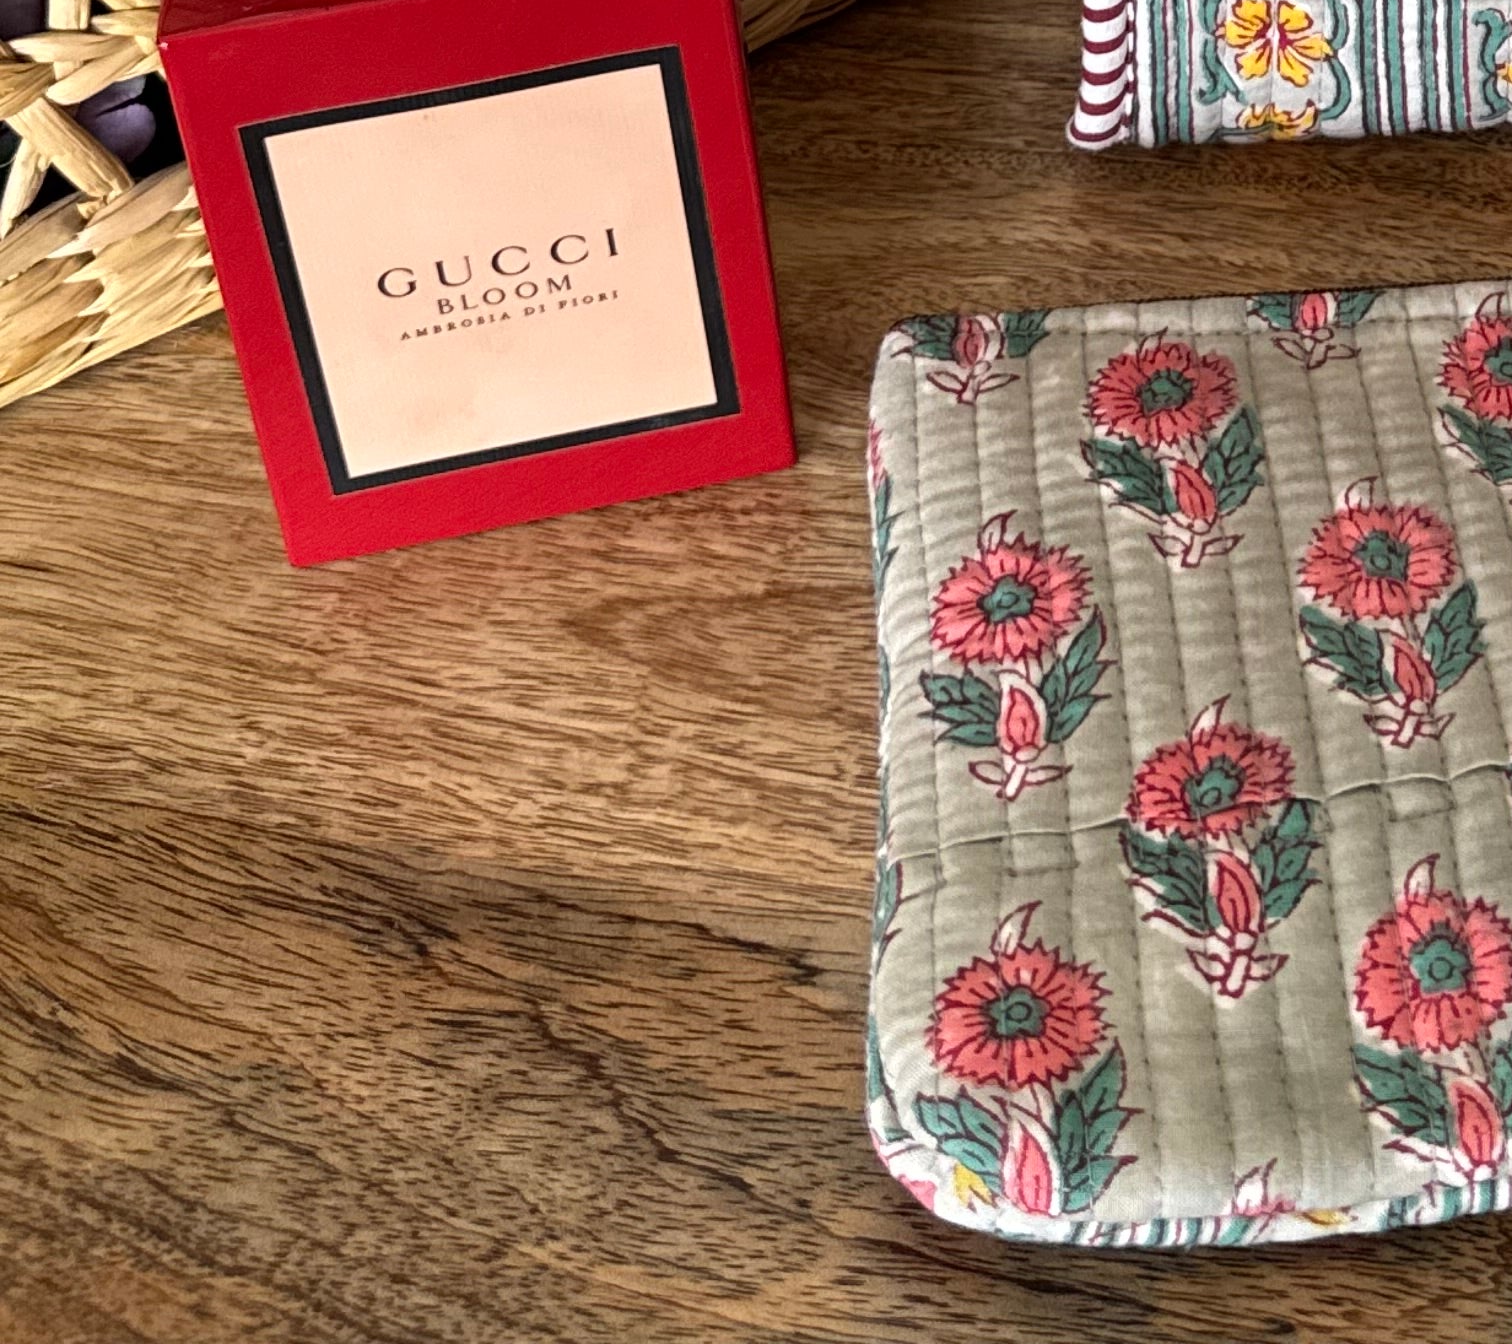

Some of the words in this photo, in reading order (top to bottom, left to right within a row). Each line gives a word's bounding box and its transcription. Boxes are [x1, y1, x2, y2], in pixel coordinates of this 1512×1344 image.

[377, 228, 618, 298] GUCCI
[400, 311, 511, 341] AMBROSIA
[523, 303, 546, 317] DI
[558, 289, 619, 310] FIORI
[436, 274, 572, 315] BLOOM
